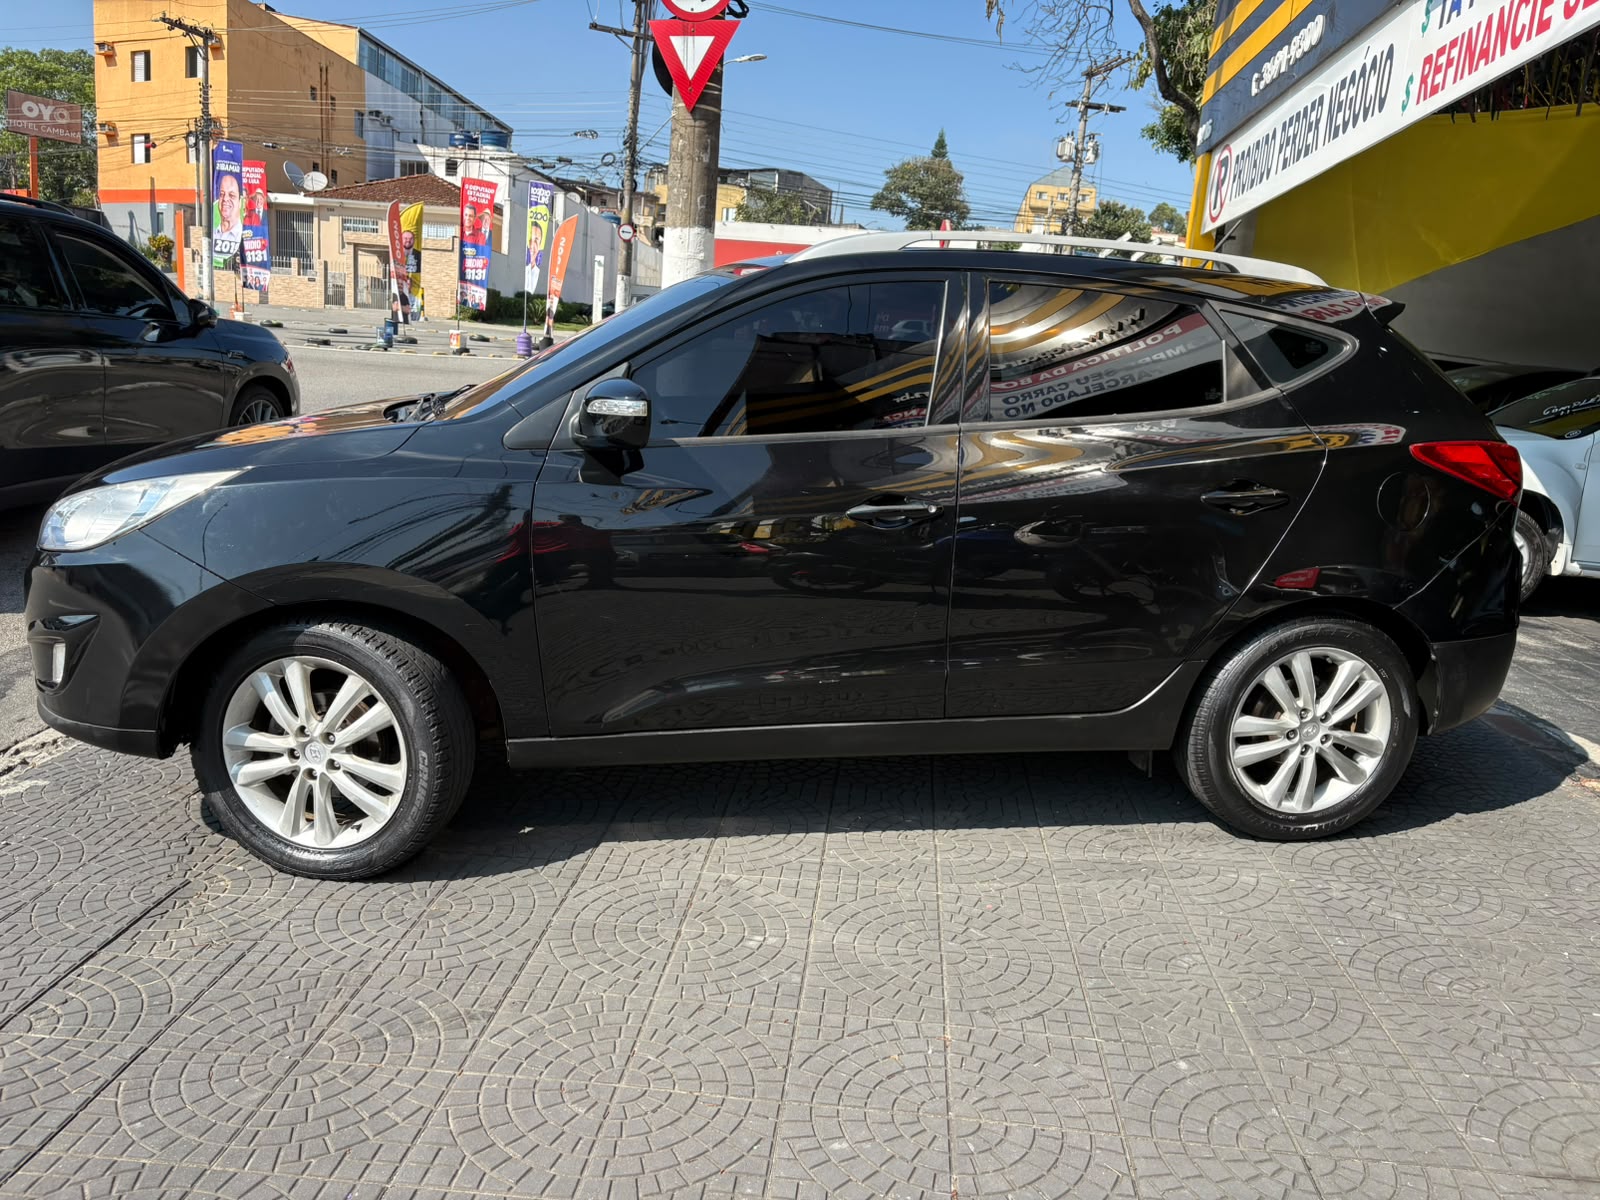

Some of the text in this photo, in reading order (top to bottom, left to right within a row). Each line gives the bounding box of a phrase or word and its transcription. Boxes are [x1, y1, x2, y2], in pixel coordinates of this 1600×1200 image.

[1416, 0, 1555, 105] REFINANCIE
[9, 119, 38, 131] HOTEL
[21, 100, 71, 124] OYO
[1230, 128, 1276, 201] PROIBIDO
[1275, 94, 1324, 175] PERDER
[1323, 43, 1394, 147] NEGÓCIO
